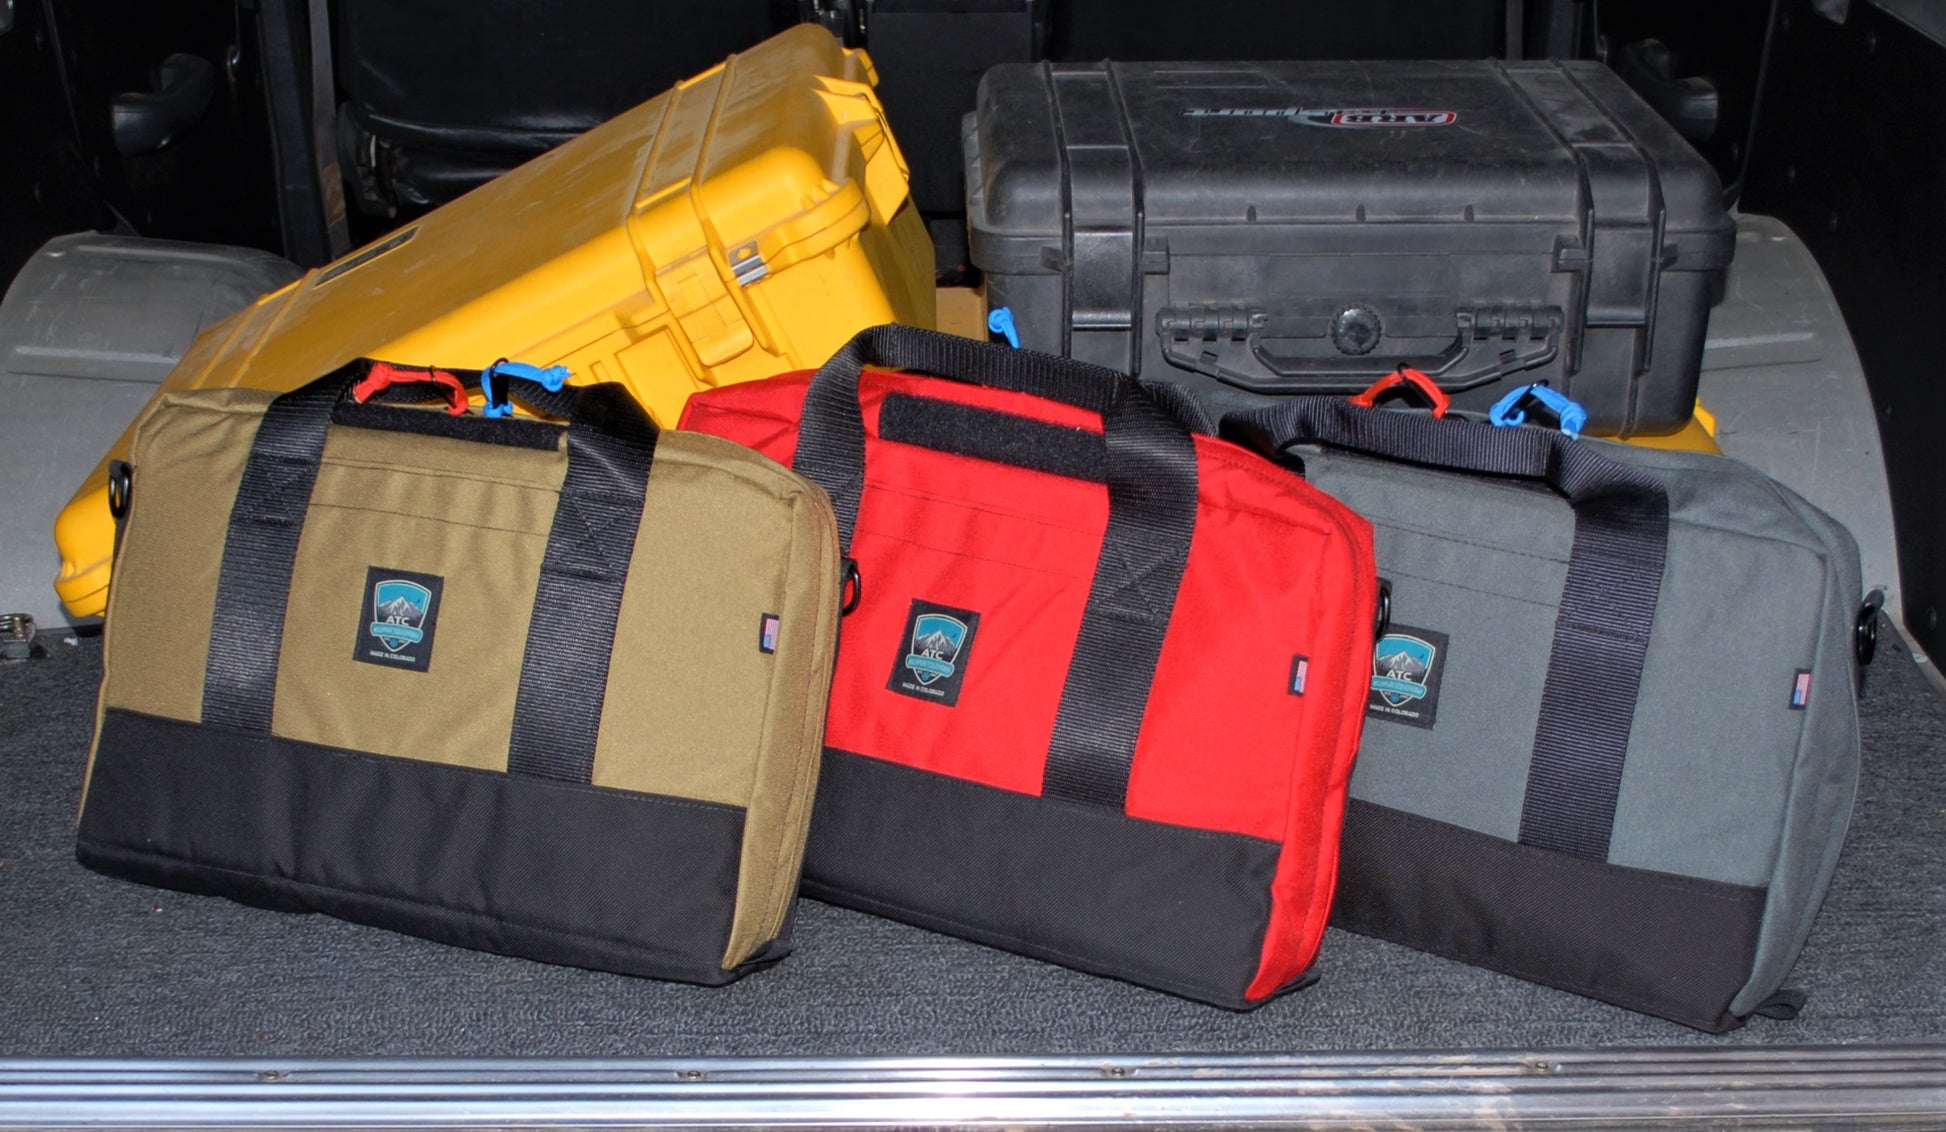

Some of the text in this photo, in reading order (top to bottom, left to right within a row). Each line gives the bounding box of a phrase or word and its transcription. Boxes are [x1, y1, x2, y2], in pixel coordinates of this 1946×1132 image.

[386, 615, 410, 626] ATC
[389, 653, 415, 662] COLORADO
[921, 648, 944, 660] ATC
[1387, 669, 1412, 681] ATC
[920, 686, 944, 696] COLORADO
[1391, 708, 1419, 718] COLORADO
